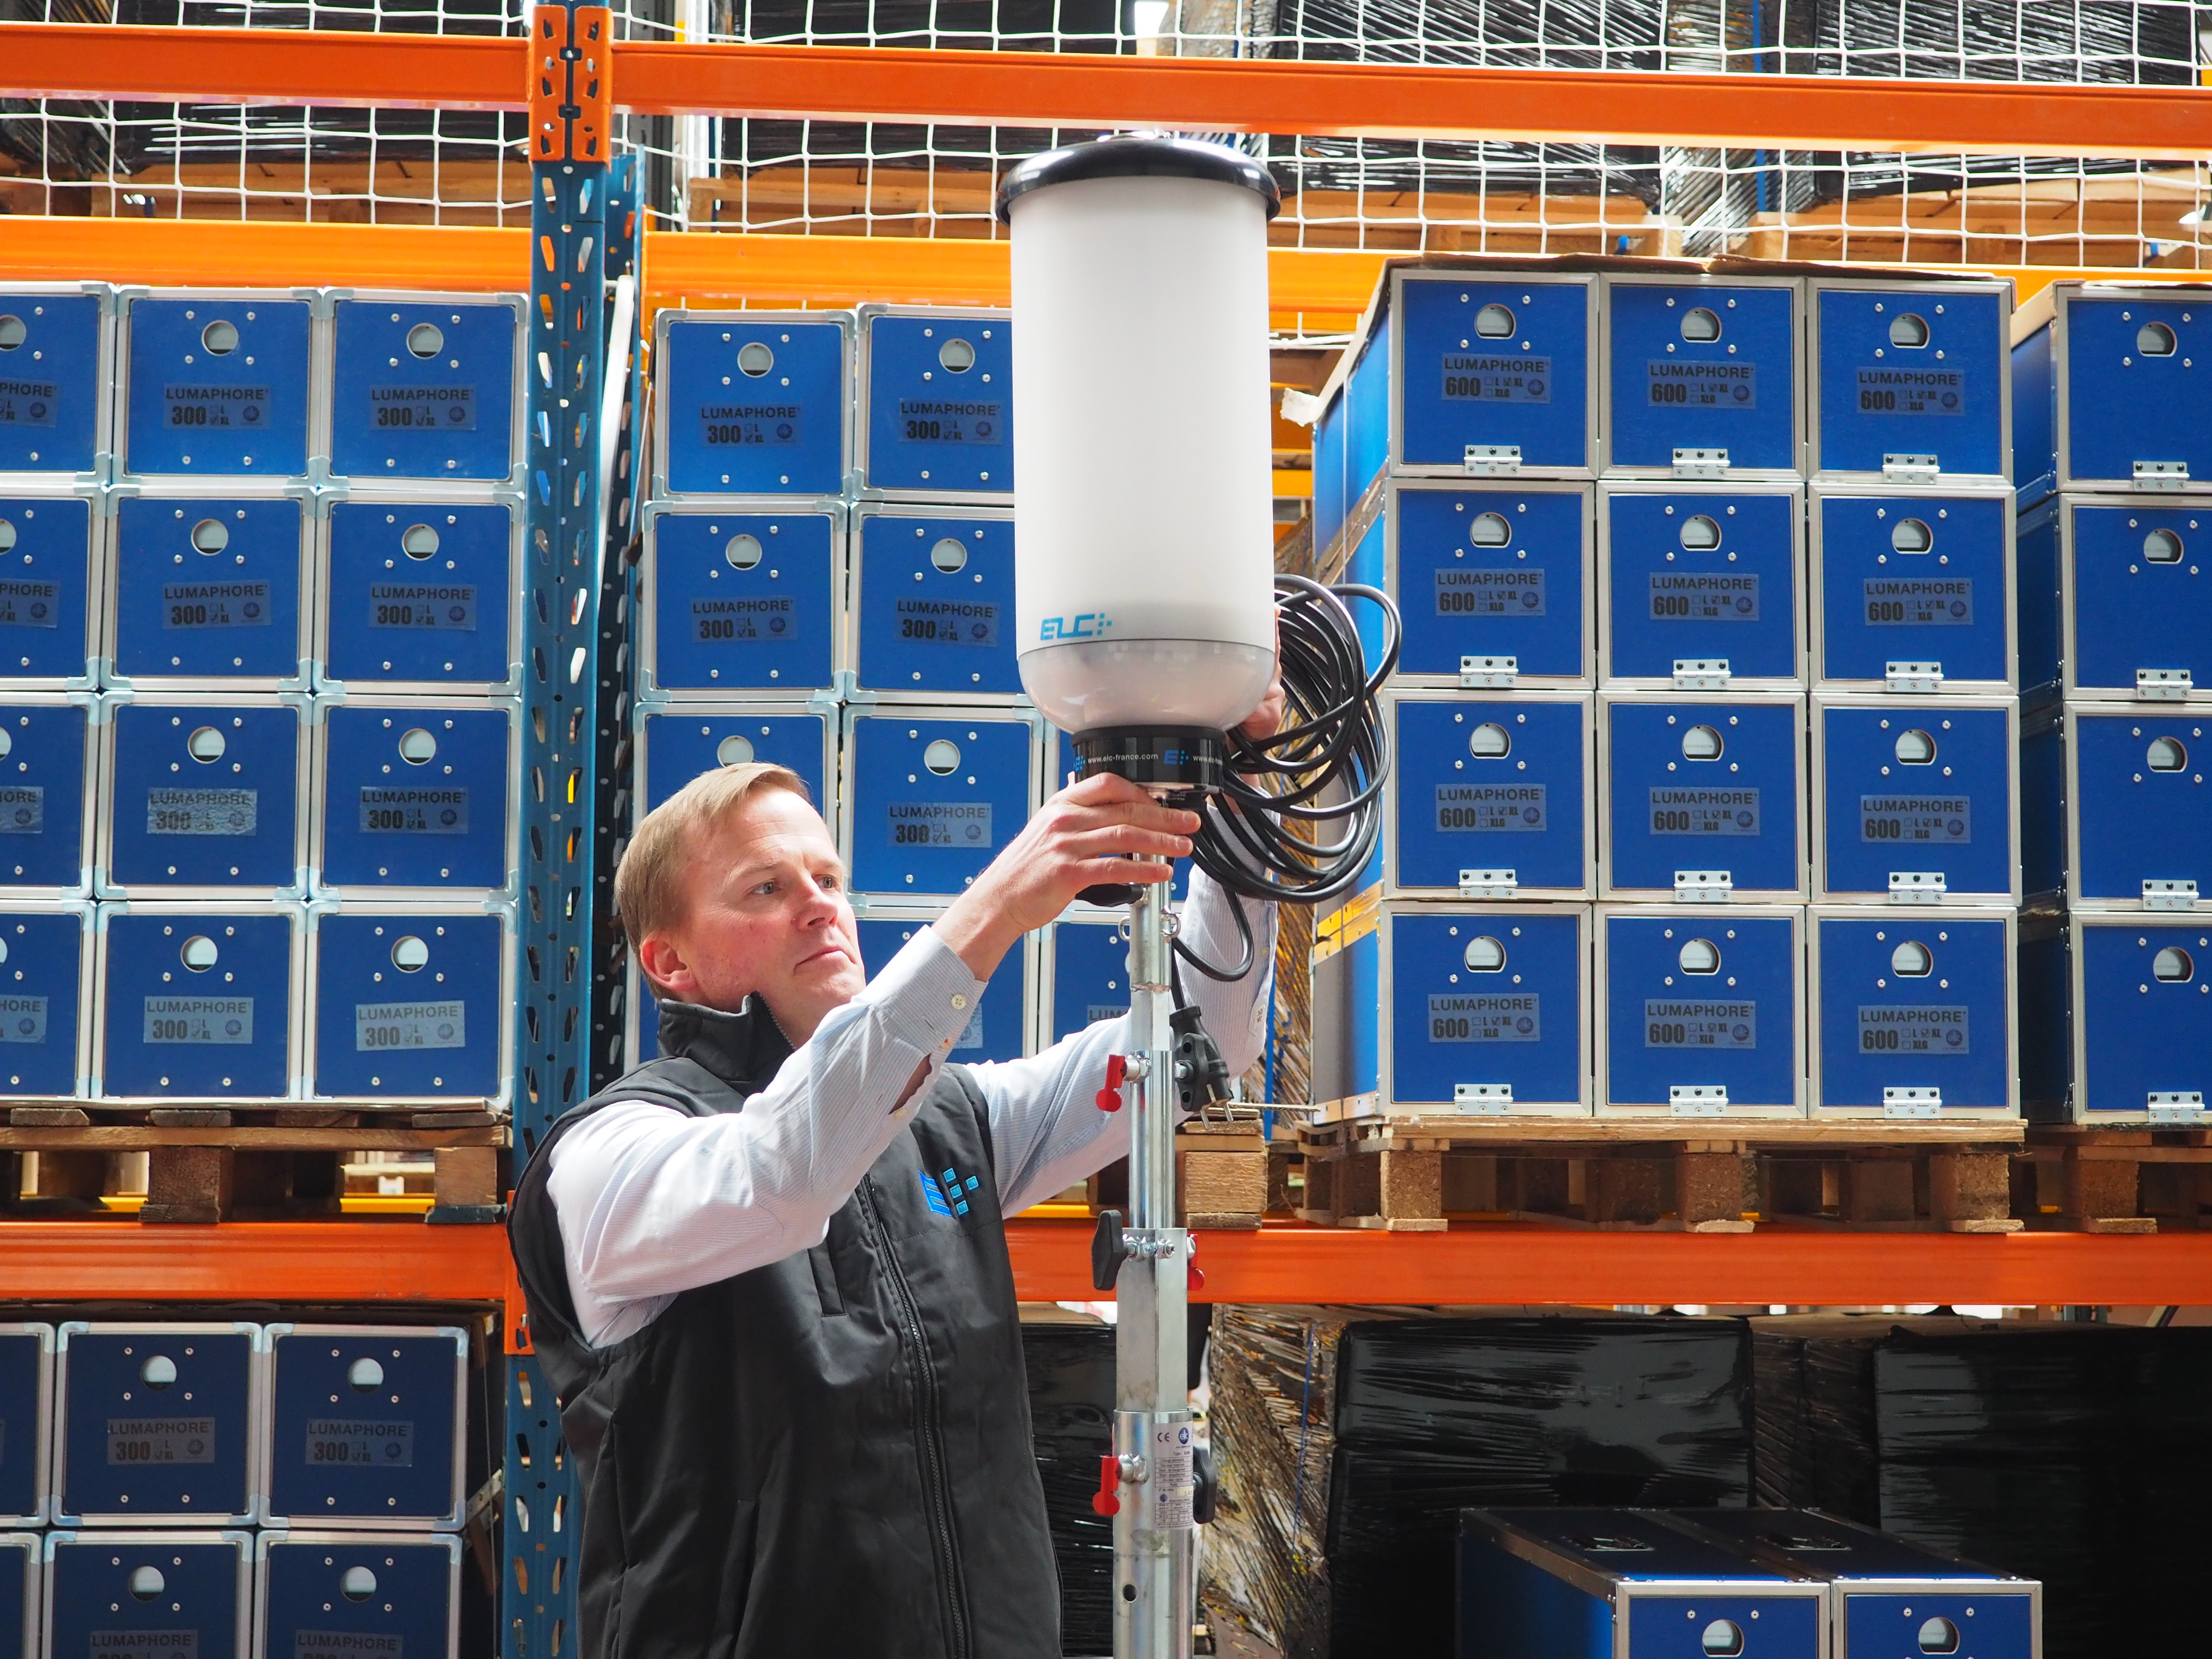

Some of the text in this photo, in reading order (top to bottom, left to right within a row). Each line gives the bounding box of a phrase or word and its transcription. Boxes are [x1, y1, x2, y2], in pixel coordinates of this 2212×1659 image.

[1444, 358, 1544, 373] LUMAPHORE
[1650, 365, 1750, 378] LUMAPHORE
[1445, 377, 1481, 396] 600
[1859, 373, 1958, 385] LUMAPHORE
[166, 388, 264, 400] LUMAPHORE
[372, 390, 470, 400] LUMAPHORE
[1652, 384, 1686, 403] 600
[1861, 390, 1895, 410] 600
[172, 406, 206, 425] 300
[701, 408, 797, 419] LUMAPHORE
[901, 403, 996, 415] LUMAPHORE
[378, 408, 412, 426] 300
[708, 425, 741, 444] 300
[907, 421, 940, 439] 300
[1438, 574, 1538, 585] LUMAPHORE
[1652, 577, 1752, 590] LUMAPHORE
[165, 585, 264, 600] LUMAPHORE
[371, 587, 470, 600] LUMAPHORE
[1866, 583, 1966, 595] LUMAPHORE
[693, 600, 789, 614] LUMAPHORE
[898, 601, 994, 617] LUMAPHORE
[1439, 591, 1474, 612] 600
[1654, 596, 1689, 615] 600
[171, 605, 206, 625] 300
[377, 605, 411, 625] 300
[1868, 602, 1903, 621] 600
[700, 619, 733, 638] 300
[902, 619, 936, 638] 300
[1088, 754, 1158, 764] www.elc-france.com
[362, 792, 462, 803] LUMAPHORE
[1438, 789, 1539, 801] LUMAPHORE
[1652, 792, 1753, 805] LUMAPHORE
[890, 807, 987, 818] LUMAPHORE
[1863, 801, 1964, 812] LUMAPHORE
[156, 811, 191, 830] 300
[369, 810, 403, 829] 300
[1441, 808, 1476, 827] 600
[1654, 810, 1689, 830] 600
[896, 824, 929, 843] 300
[1865, 818, 1900, 838] 600
[147, 1001, 247, 1013] LUMAPHORE
[1431, 999, 1533, 1011] LUMAPHORE
[1647, 1005, 1749, 1017] LUMAPHORE
[359, 1007, 458, 1020] LUMAPHORE
[1861, 1011, 1962, 1022] LUMAPHORE
[152, 1020, 187, 1039] 300
[1433, 1018, 1468, 1038] 600
[1649, 1023, 1685, 1043] 600
[365, 1026, 399, 1046] 300
[1863, 1030, 1898, 1049] 600
[110, 1422, 209, 1435] LUMAPHORE
[309, 1423, 407, 1436] LUMAPHORE
[1157, 1432, 1170, 1443] CE
[115, 1442, 151, 1460] 300
[314, 1442, 348, 1461] 300
[93, 1635, 192, 1647] LUMAPHORE
[298, 1635, 397, 1650] LUMAPHORE
